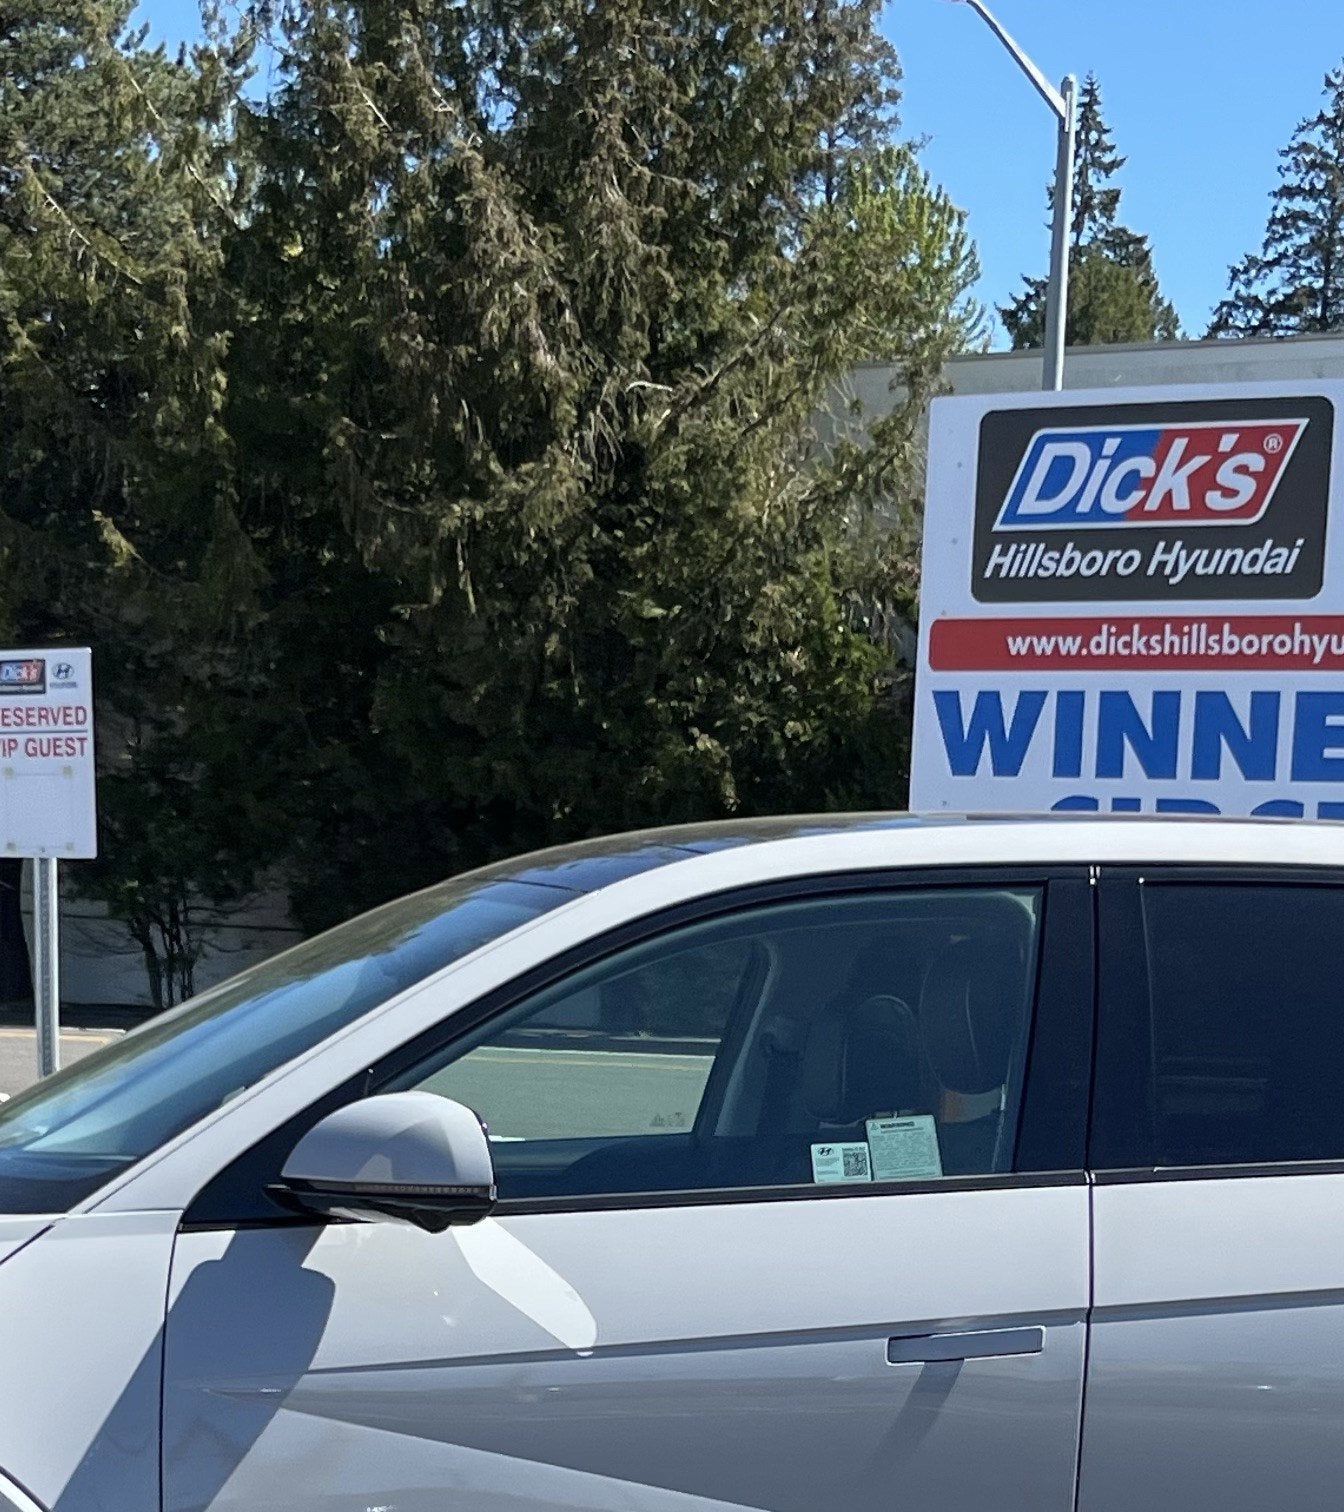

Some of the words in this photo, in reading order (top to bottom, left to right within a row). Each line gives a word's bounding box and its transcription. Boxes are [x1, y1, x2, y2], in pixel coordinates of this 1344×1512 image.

[1016, 432, 1265, 515] Dick's
[984, 541, 1140, 579] Hillsboro
[1146, 537, 1305, 585] Hyundai
[24, 737, 87, 757] GUEST
